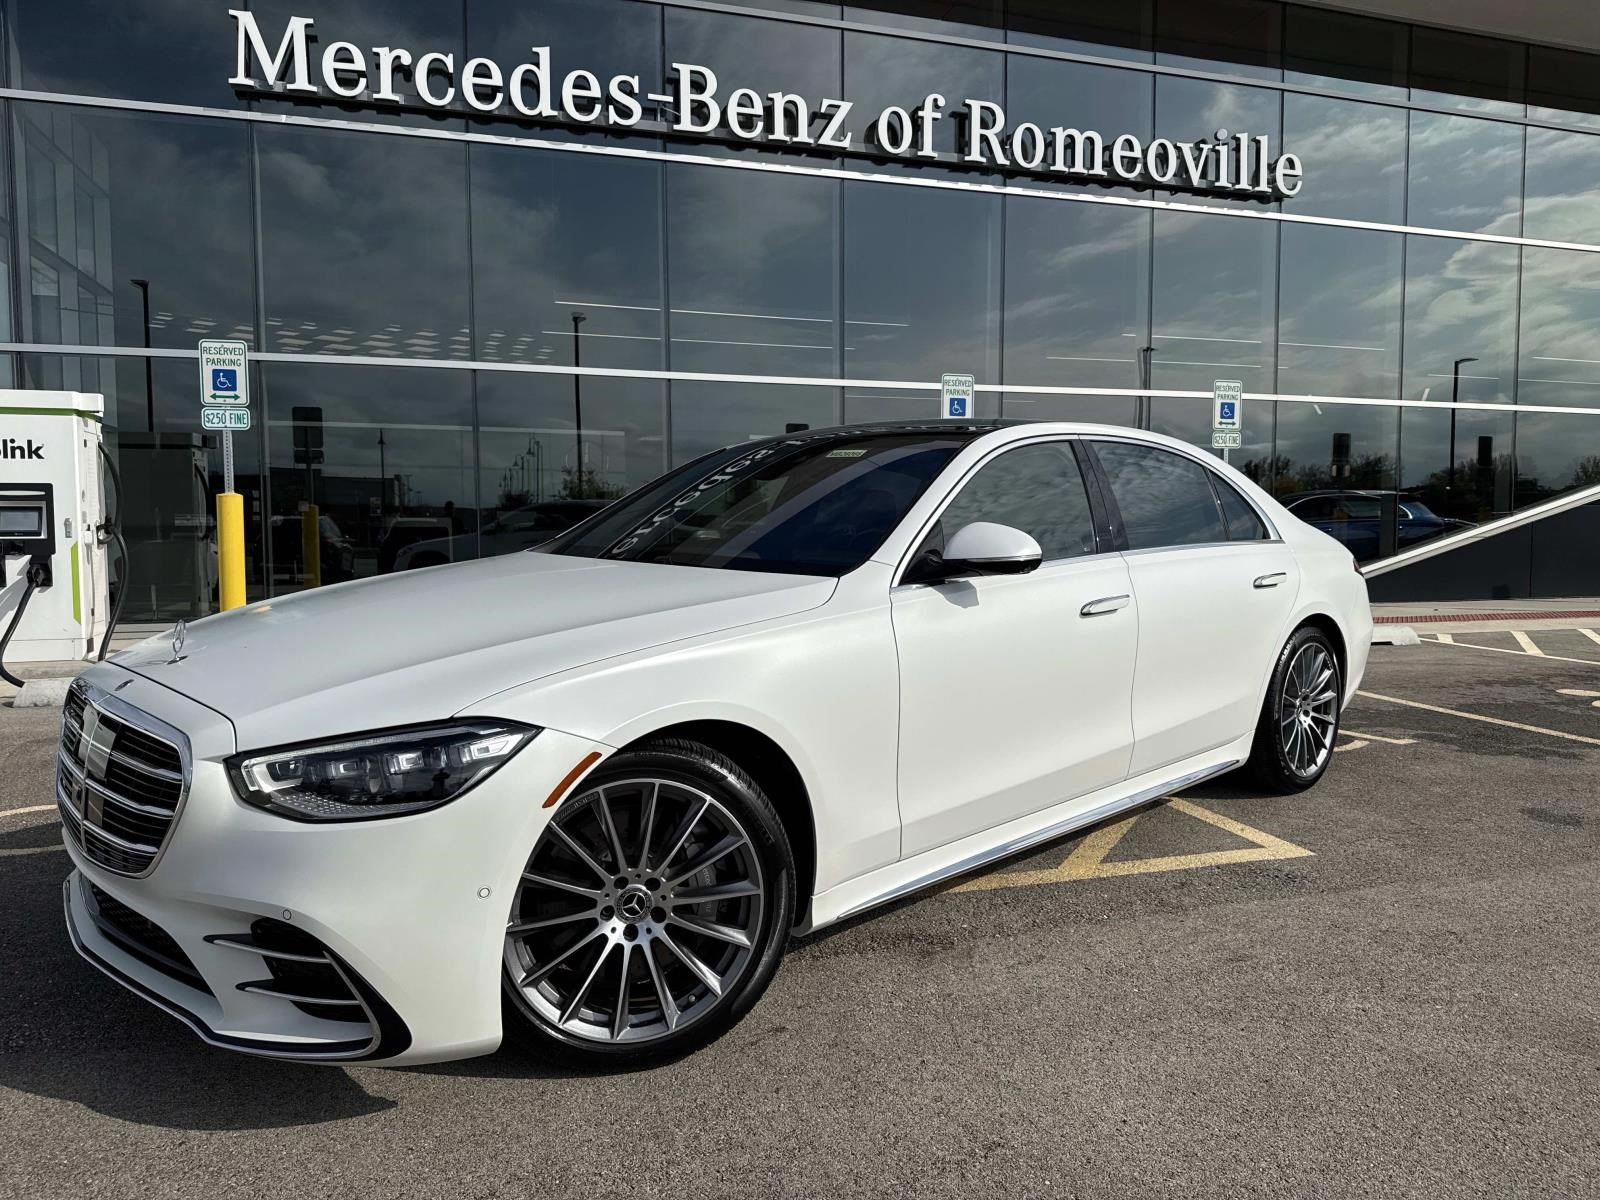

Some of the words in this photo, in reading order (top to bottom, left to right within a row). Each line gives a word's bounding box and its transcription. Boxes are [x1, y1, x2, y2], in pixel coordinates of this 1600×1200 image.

[228, 9, 854, 151] Mercedes-Benz
[877, 93, 946, 158] of
[964, 98, 1303, 196] Romeoville
[203, 346, 244, 356] RESERVED
[206, 357, 242, 367] PARKING
[944, 379, 972, 387] RESERVED
[1216, 384, 1240, 392] RESERVED
[945, 388, 970, 396] PARKING
[205, 412, 226, 425] $250
[229, 412, 247, 425] FINE
[1228, 435, 1239, 445] FINE
[0, 438, 45, 460] link
